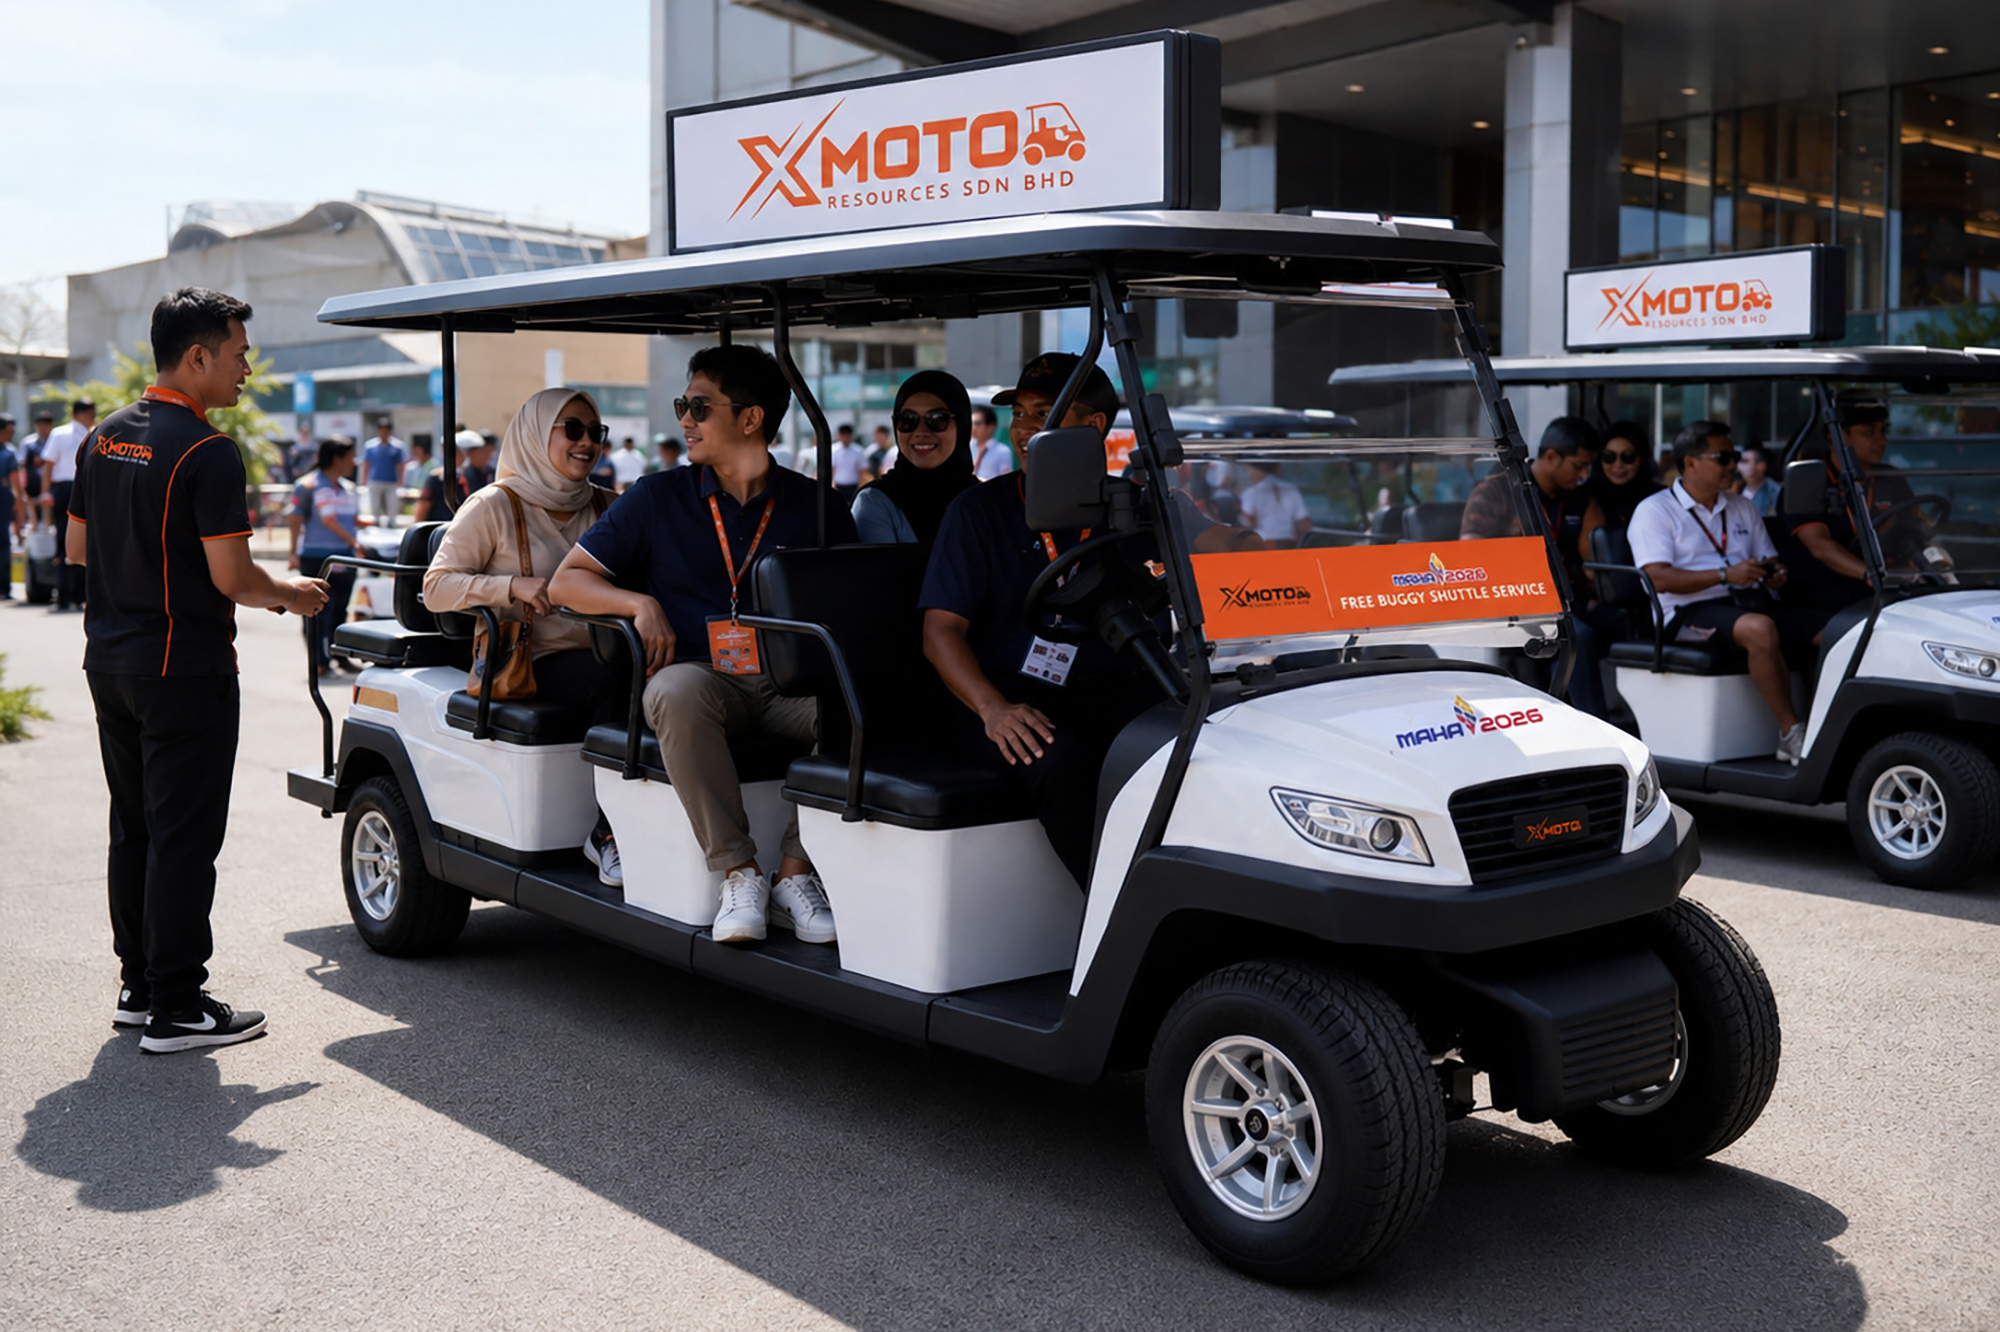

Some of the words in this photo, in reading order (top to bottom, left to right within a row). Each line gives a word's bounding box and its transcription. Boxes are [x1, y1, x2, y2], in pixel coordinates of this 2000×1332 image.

[727, 96, 1018, 222] XMOTO
[828, 183, 949, 209] RESOURCES
[963, 177, 1009, 197] SDN
[1024, 170, 1074, 190] BHD
[1596, 270, 1740, 331] XMOTO
[1712, 316, 1735, 326] SDN
[1742, 314, 1767, 325] BHD
[1219, 578, 1296, 612] XMOTO
[1340, 595, 1375, 610] FREE
[1377, 591, 1425, 607] BUGGY
[1429, 586, 1489, 603] SHUTTLE
[1491, 582, 1547, 598] SERVICE
[1396, 722, 1464, 749] MAHA
[1480, 708, 1544, 733] 2026
